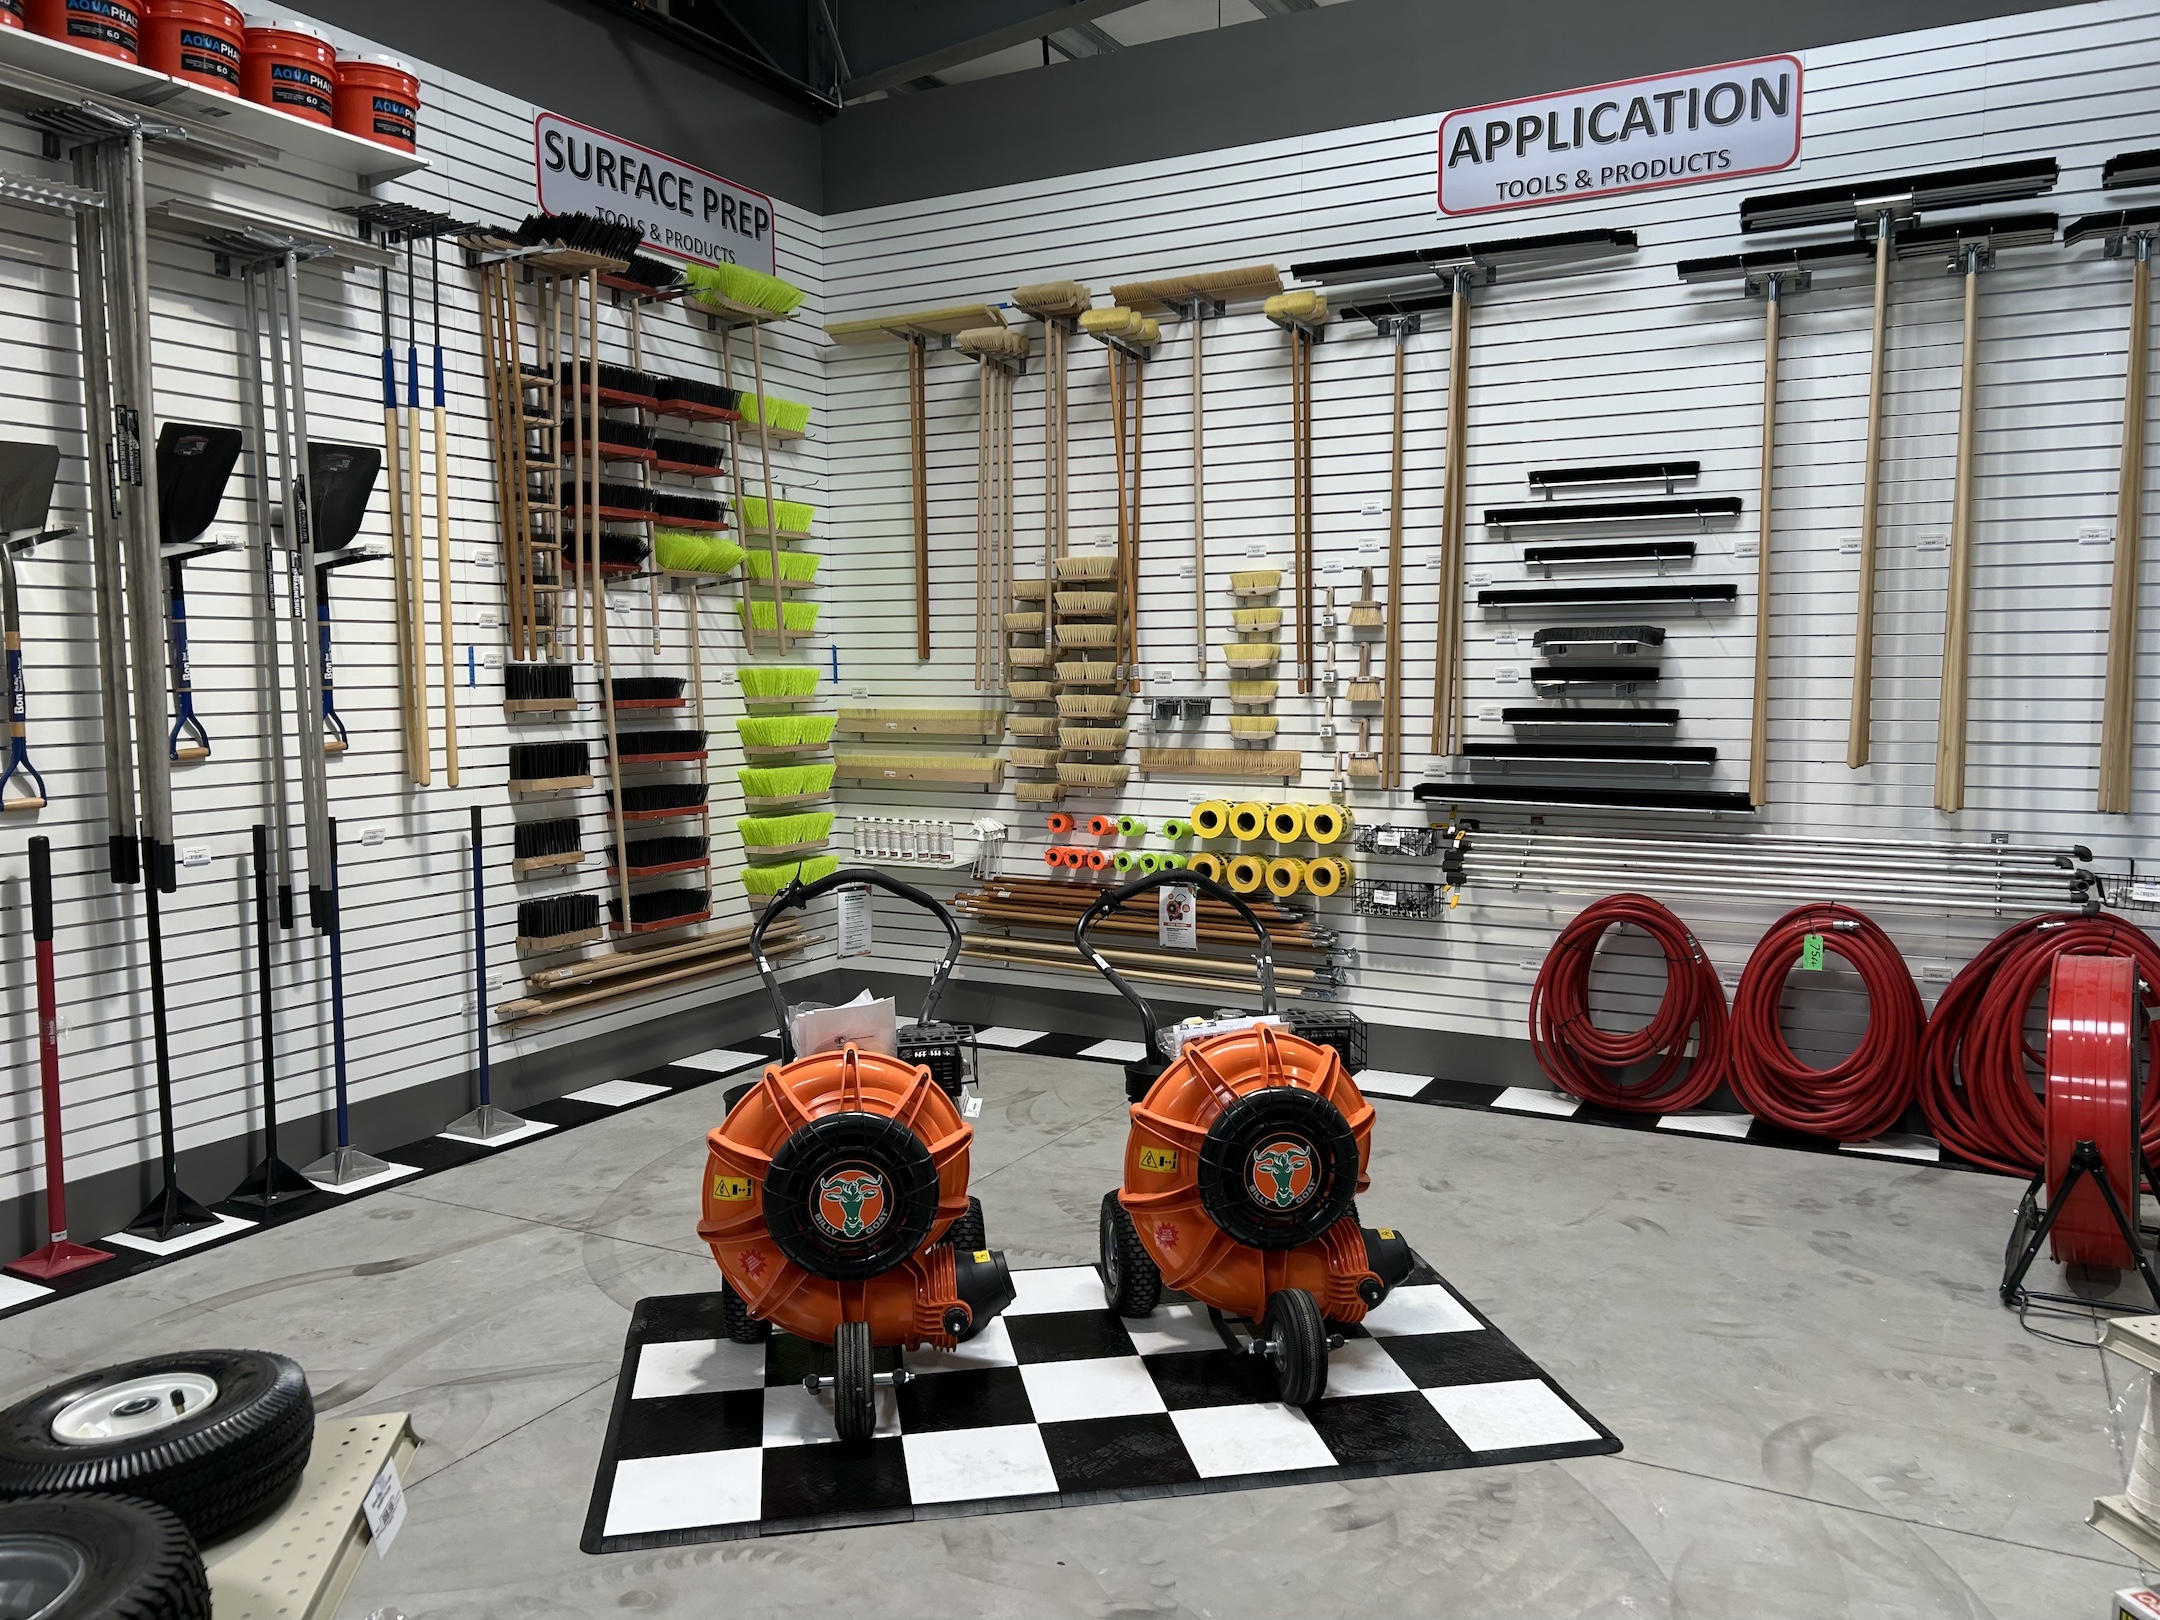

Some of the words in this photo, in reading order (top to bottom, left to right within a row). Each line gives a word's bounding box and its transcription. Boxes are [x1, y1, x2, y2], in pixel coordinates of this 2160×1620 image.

[1447, 72, 1790, 169] APPLICATION
[544, 129, 694, 218] SURFACE
[703, 186, 770, 241] PREP
[1495, 172, 1568, 202] TOOLS
[1574, 168, 1593, 190] &
[1600, 148, 1732, 186] PRODUCTS
[650, 222, 662, 242] &
[665, 228, 736, 265] PRODUCTS
[292, 574, 301, 617] MAGNESIUM
[182, 662, 191, 681] Bon
[324, 662, 333, 680] Bon
[14, 693, 24, 715] Bon
[1248, 1184, 1271, 1206] BILLY
[1295, 1180, 1317, 1204] GOAT
[814, 1212, 839, 1236] BILLY
[865, 1210, 889, 1235] GOAT
